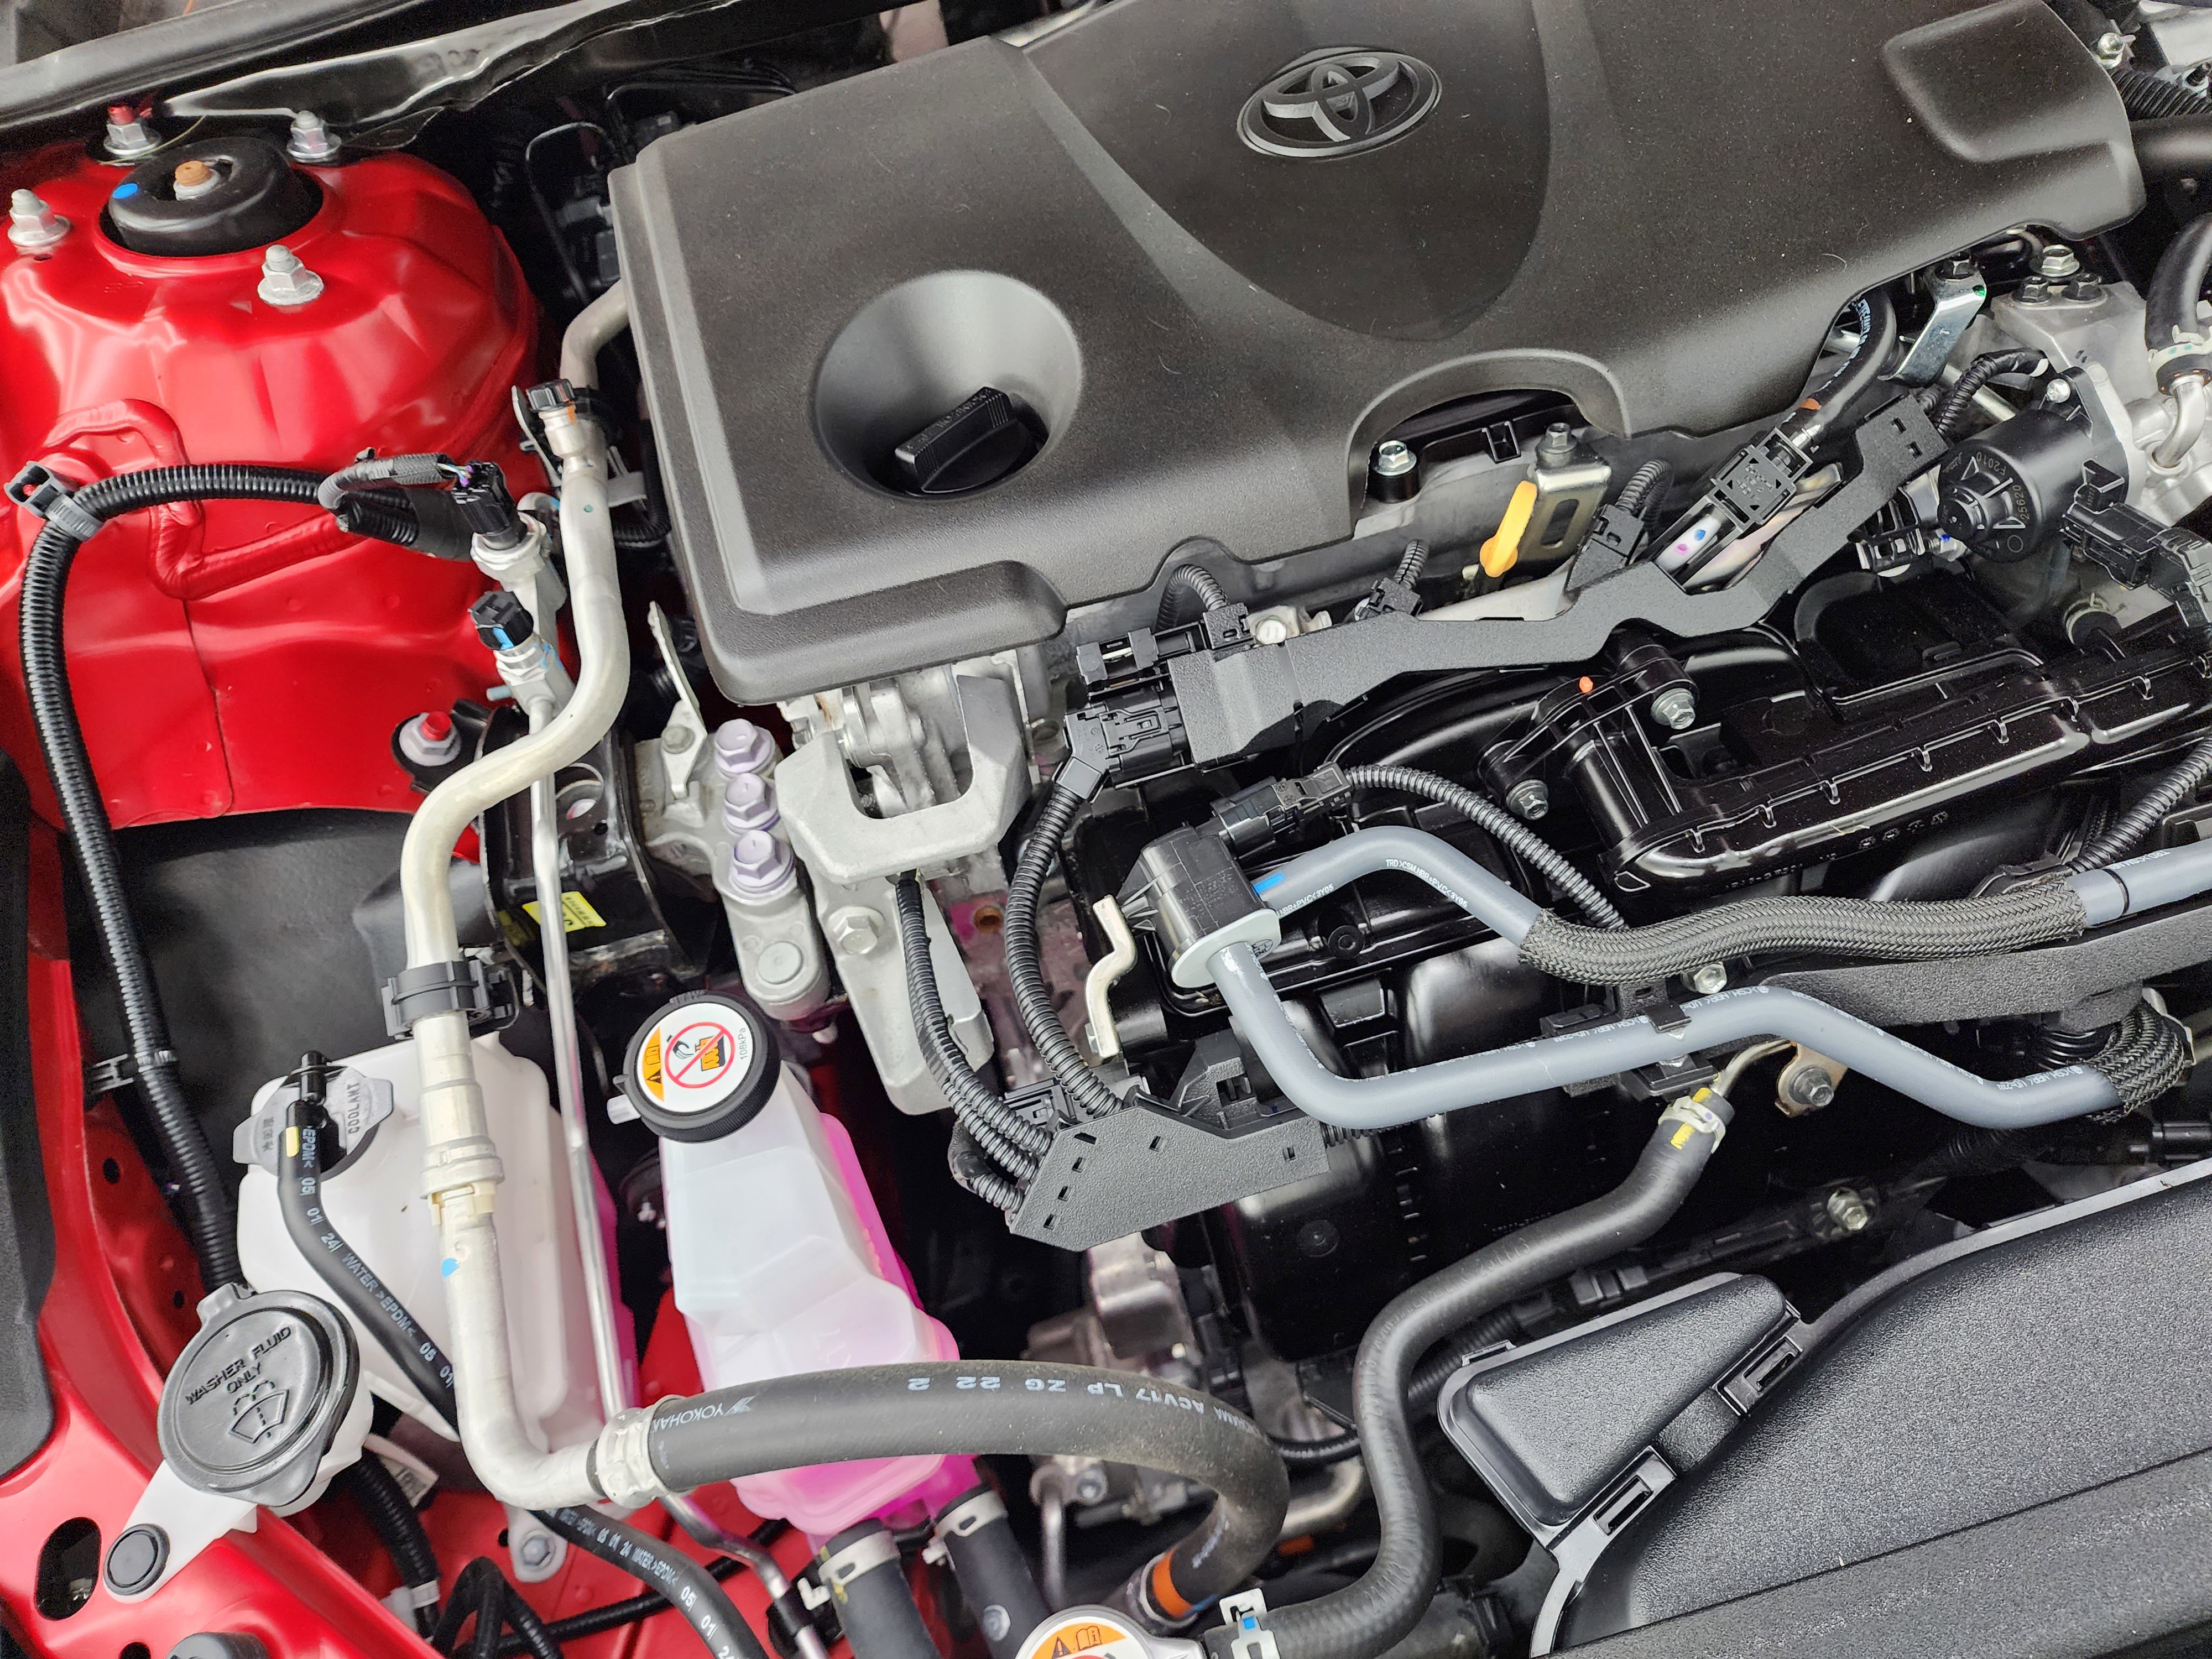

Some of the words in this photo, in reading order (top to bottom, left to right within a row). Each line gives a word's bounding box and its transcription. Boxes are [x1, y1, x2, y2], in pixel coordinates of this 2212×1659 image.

[1976, 452, 2007, 476] F2010
[2012, 484, 2030, 520] 25620
[738, 1027, 748, 1061] 108kPa
[347, 1083, 360, 1135] COOLANT
[342, 1253, 378, 1293] WATER
[185, 1358, 246, 1405] WASHER
[252, 1327, 291, 1360] FLUID
[226, 1361, 261, 1394] ONLY
[907, 1377, 931, 1391] 2
[956, 1376, 1001, 1390] 22
[1087, 1381, 1124, 1397] LP
[1135, 1387, 1204, 1414] ACV17
